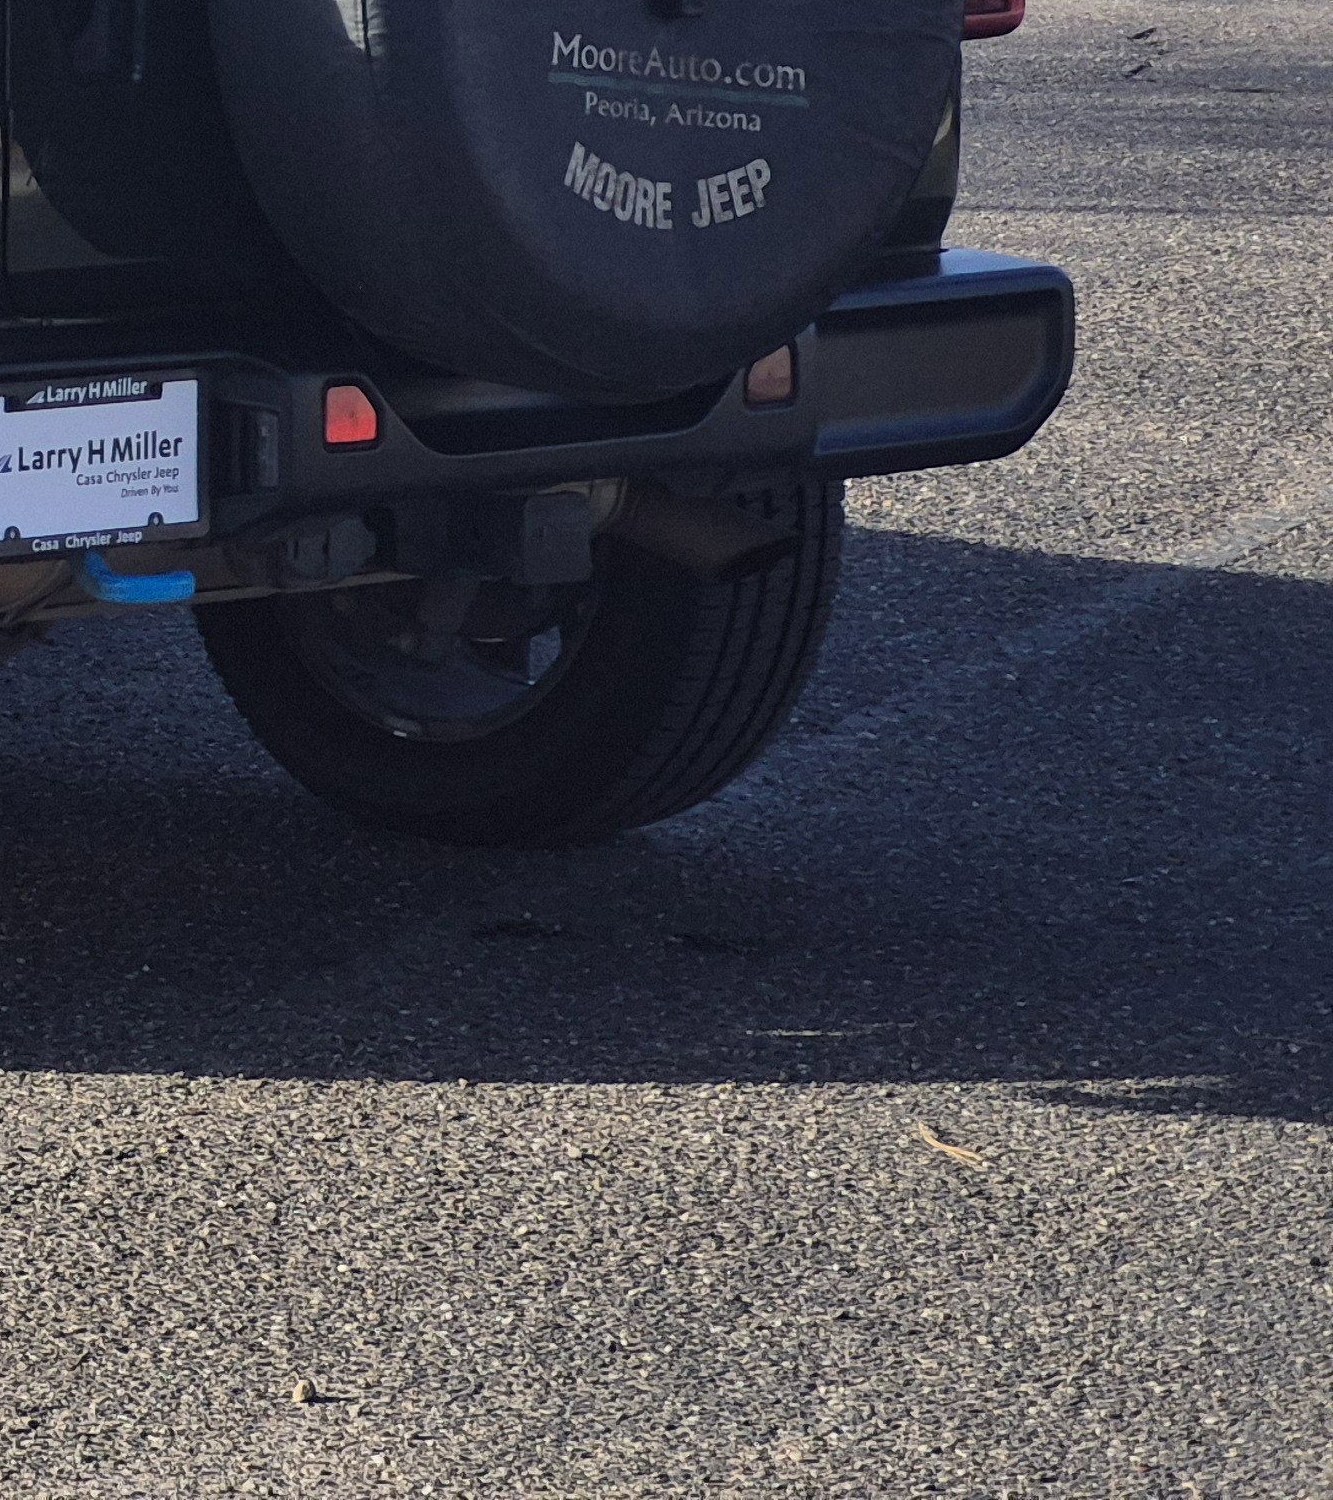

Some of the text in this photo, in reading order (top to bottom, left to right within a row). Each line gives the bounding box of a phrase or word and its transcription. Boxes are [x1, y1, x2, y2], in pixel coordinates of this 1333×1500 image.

[552, 31, 806, 91] MooreAuto.com
[585, 91, 762, 132] Peoria, Arizona
[564, 140, 771, 230] MOORE JEEP
[46, 377, 147, 403] Larry H Miller
[18, 430, 183, 474] Larry H Miller
[76, 467, 179, 486] Casa Chrysler Jeep
[121, 487, 149, 499] Driven
[151, 485, 162, 497] By
[32, 530, 143, 551] Casa Chrysler Jeep
